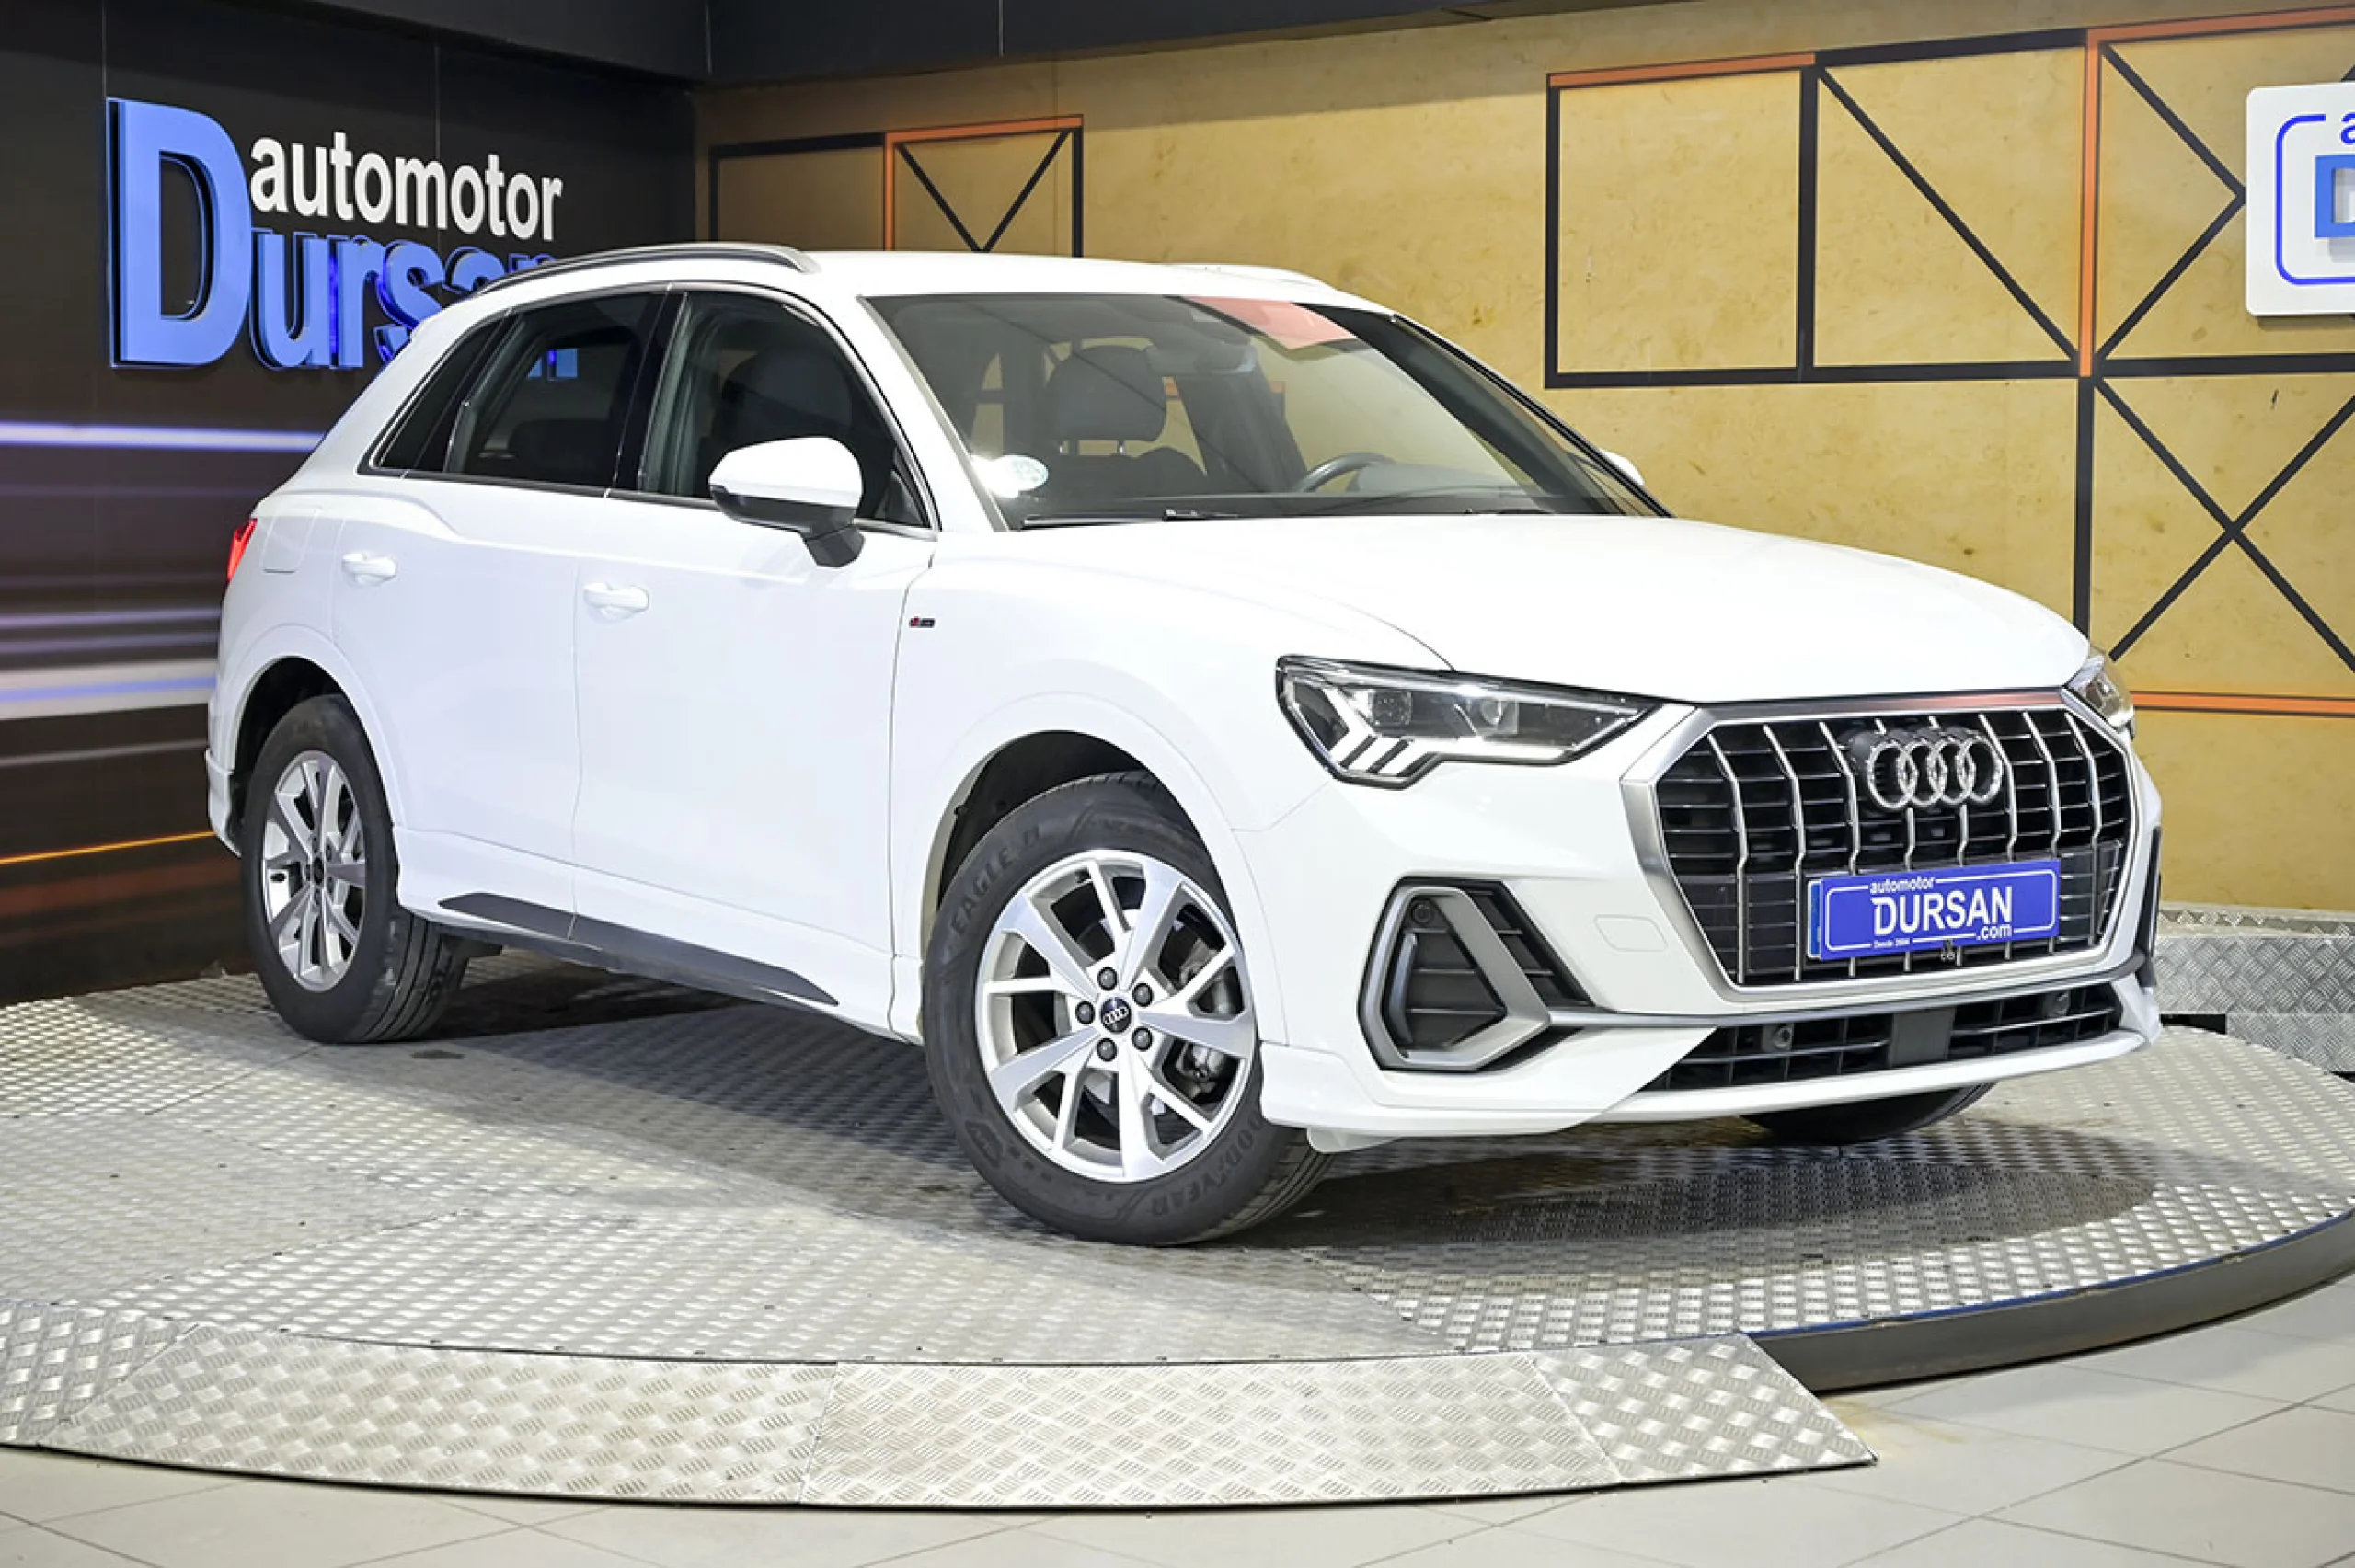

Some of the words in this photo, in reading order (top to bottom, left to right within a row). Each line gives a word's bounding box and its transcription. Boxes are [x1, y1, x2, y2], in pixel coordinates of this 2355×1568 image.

[250, 131, 563, 241] automotor
[106, 96, 565, 372] Durs
[1869, 876, 1935, 895] automotor
[1870, 885, 2013, 936] DURSAN
[1976, 923, 2013, 940] .com
[1150, 1109, 1265, 1217] OODYEAR
